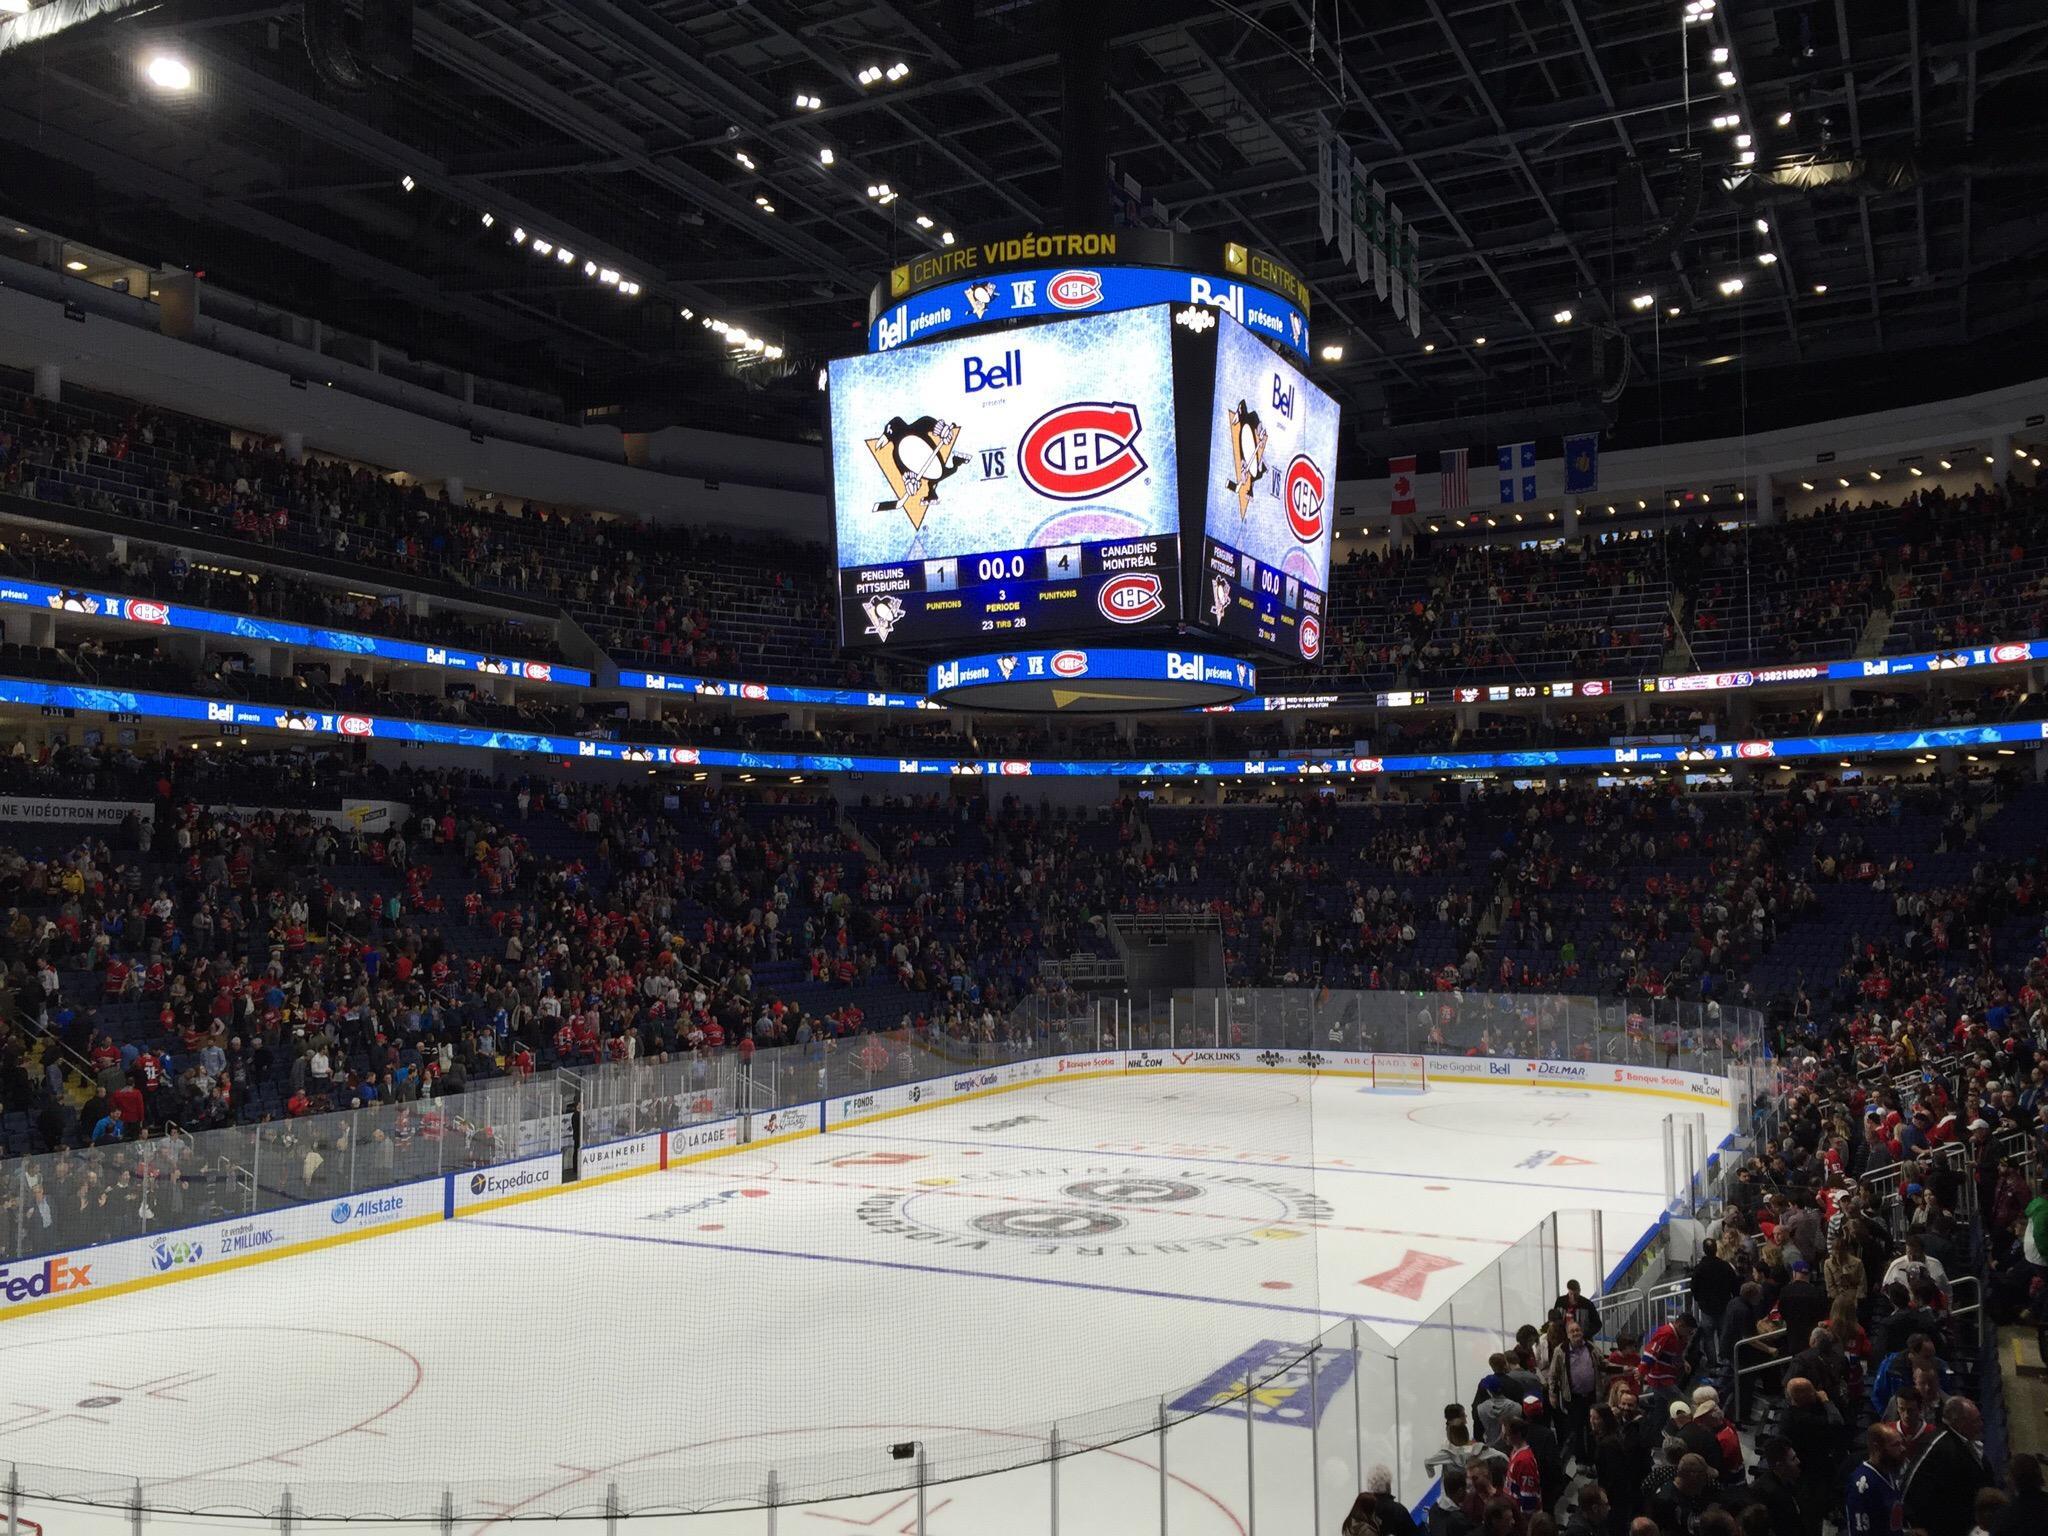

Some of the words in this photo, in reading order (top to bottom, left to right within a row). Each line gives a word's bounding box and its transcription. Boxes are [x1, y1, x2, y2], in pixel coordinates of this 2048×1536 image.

[913, 246, 978, 284] CENTRE
[983, 231, 1116, 265] VIDÉOTRON
[1251, 256, 1297, 297] CENTRE
[1190, 277, 1244, 324] Bell
[1248, 306, 1284, 334] présente
[878, 304, 908, 352] Bell
[910, 306, 951, 337] présente
[1012, 282, 1036, 308] VS
[963, 349, 1022, 394] Bell
[1272, 372, 1295, 420] Bell
[981, 449, 1006, 479] VS
[1271, 469, 1281, 498] VS
[1101, 542, 1158, 558] CANADIENS
[978, 555, 1025, 581] 00.0
[1057, 554, 1070, 571] 4
[1102, 555, 1157, 571] MONTRÉAL
[861, 568, 904, 582] PENGUINS
[936, 566, 945, 583] 1
[1261, 569, 1280, 595] 00.0
[856, 580, 910, 594] PITTSBURGH
[998, 589, 1007, 601] 3
[1039, 589, 1077, 601] PUNITIONS
[926, 600, 962, 611] PUNITIONS
[986, 601, 1021, 613] PERIODE
[982, 620, 994, 631] 23
[1014, 617, 1027, 628] 28
[426, 647, 446, 666] Bell
[1167, 652, 1204, 682] Bell
[1205, 666, 1233, 681] présente
[1863, 660, 1889, 676] Bell
[645, 673, 665, 690] Bell
[937, 660, 959, 691] Bell
[959, 667, 990, 684] présente
[867, 692, 887, 706] Bell
[207, 702, 233, 723] Bell
[579, 740, 596, 757] Bell
[1614, 748, 1638, 763] Bell
[899, 760, 919, 773] Bell
[1244, 761, 1265, 774] Bell
[22, 803, 95, 820] VIDÉOTRON
[1066, 1057, 1092, 1070] Banque
[1093, 1056, 1115, 1067] Scotia
[1127, 1058, 1163, 1069] NHL.COM
[1193, 1052, 1215, 1062] JACK
[1343, 1057, 1361, 1065] AIR
[1429, 1060, 1448, 1071] Fibe
[1449, 1061, 1482, 1074] Gigabit
[1489, 1062, 1511, 1075] Bell
[1538, 1062, 1586, 1077] DELMAR
[980, 1073, 998, 1087] Cardio
[1626, 1072, 1660, 1085] Banque
[1661, 1075, 1685, 1087] Scotia
[1691, 1083, 1721, 1097] NHL.COM
[853, 1095, 874, 1109] FONDS
[688, 1135, 700, 1148] LA
[701, 1128, 726, 1143] CAGE
[582, 1142, 647, 1166] AUBAINERIE
[486, 1168, 550, 1195] Expedia.ca
[353, 1195, 404, 1219] Allstate
[221, 1229, 230, 1238] Ce
[229, 1222, 254, 1236] vendredi
[220, 1238, 232, 1254] 22
[233, 1229, 274, 1251] MILLIONS
[151, 1241, 203, 1272] MAX
[0, 1256, 93, 1302] FedEx
